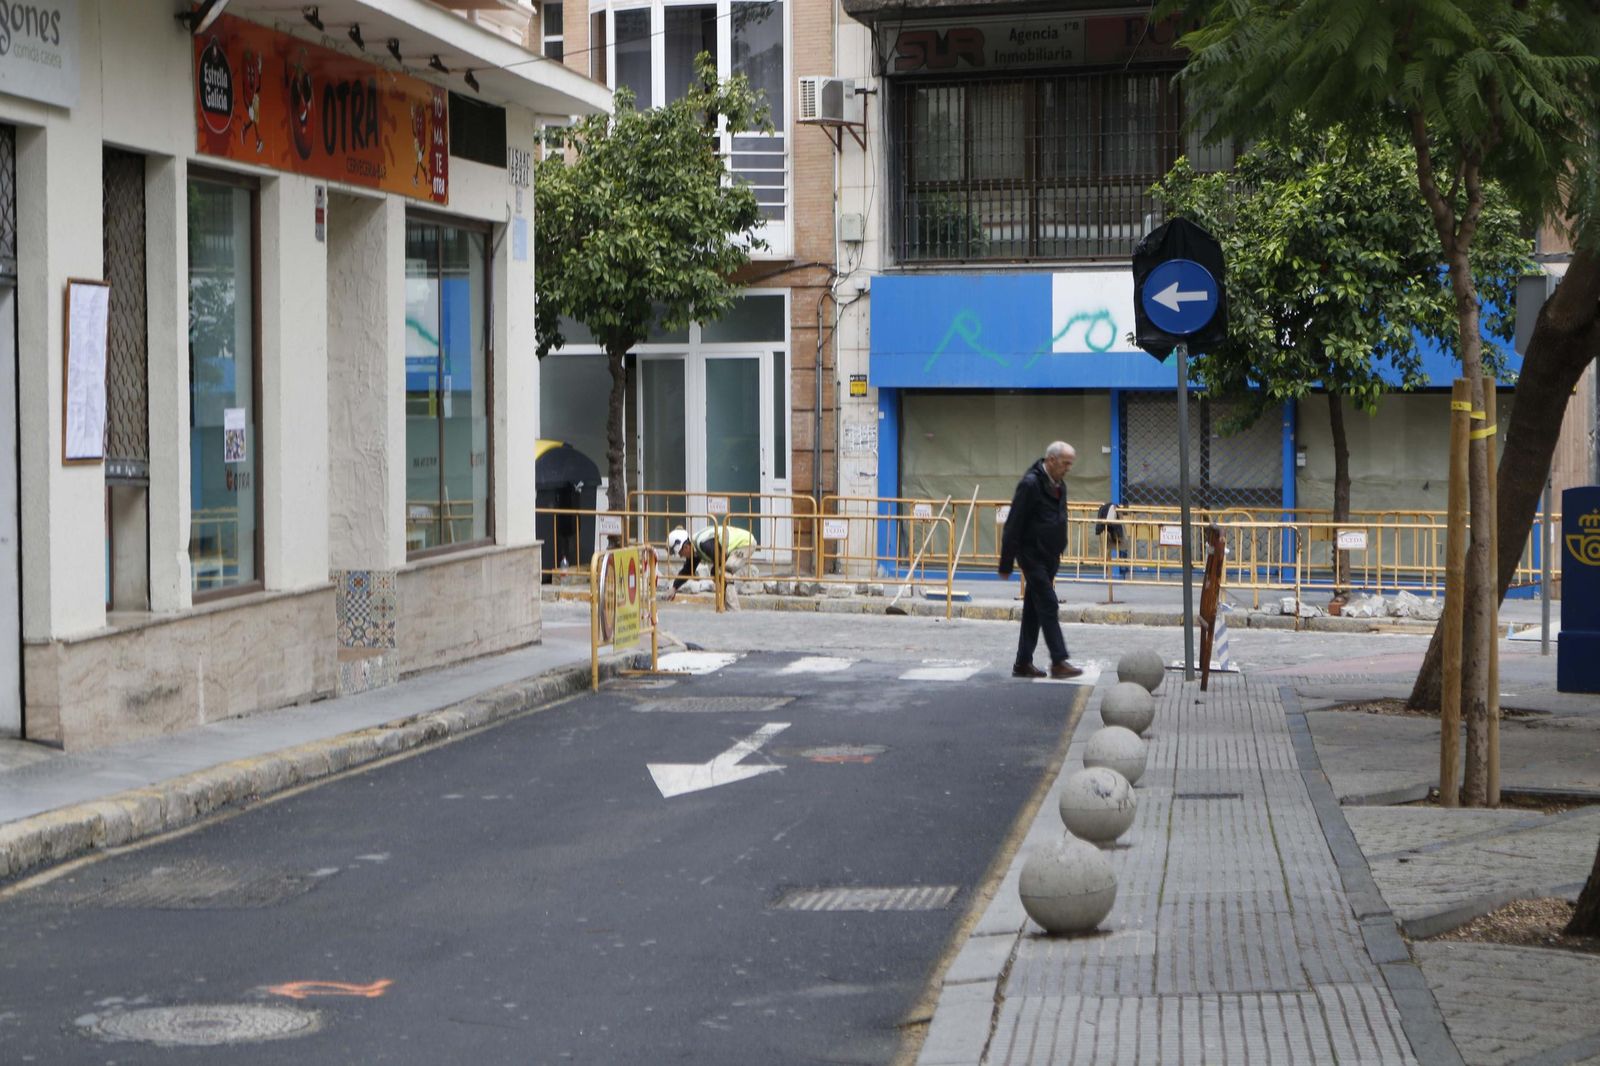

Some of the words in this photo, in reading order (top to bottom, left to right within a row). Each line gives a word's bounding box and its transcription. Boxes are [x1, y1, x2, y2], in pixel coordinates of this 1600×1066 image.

[1009, 27, 1058, 46] Agencia
[995, 46, 1072, 65] Inmobiliaria
[204, 62, 228, 89] Estrella
[205, 85, 228, 112] Galicia
[322, 78, 379, 156] OTRA
[435, 152, 443, 174] TE
[432, 176, 446, 197] OTRA
